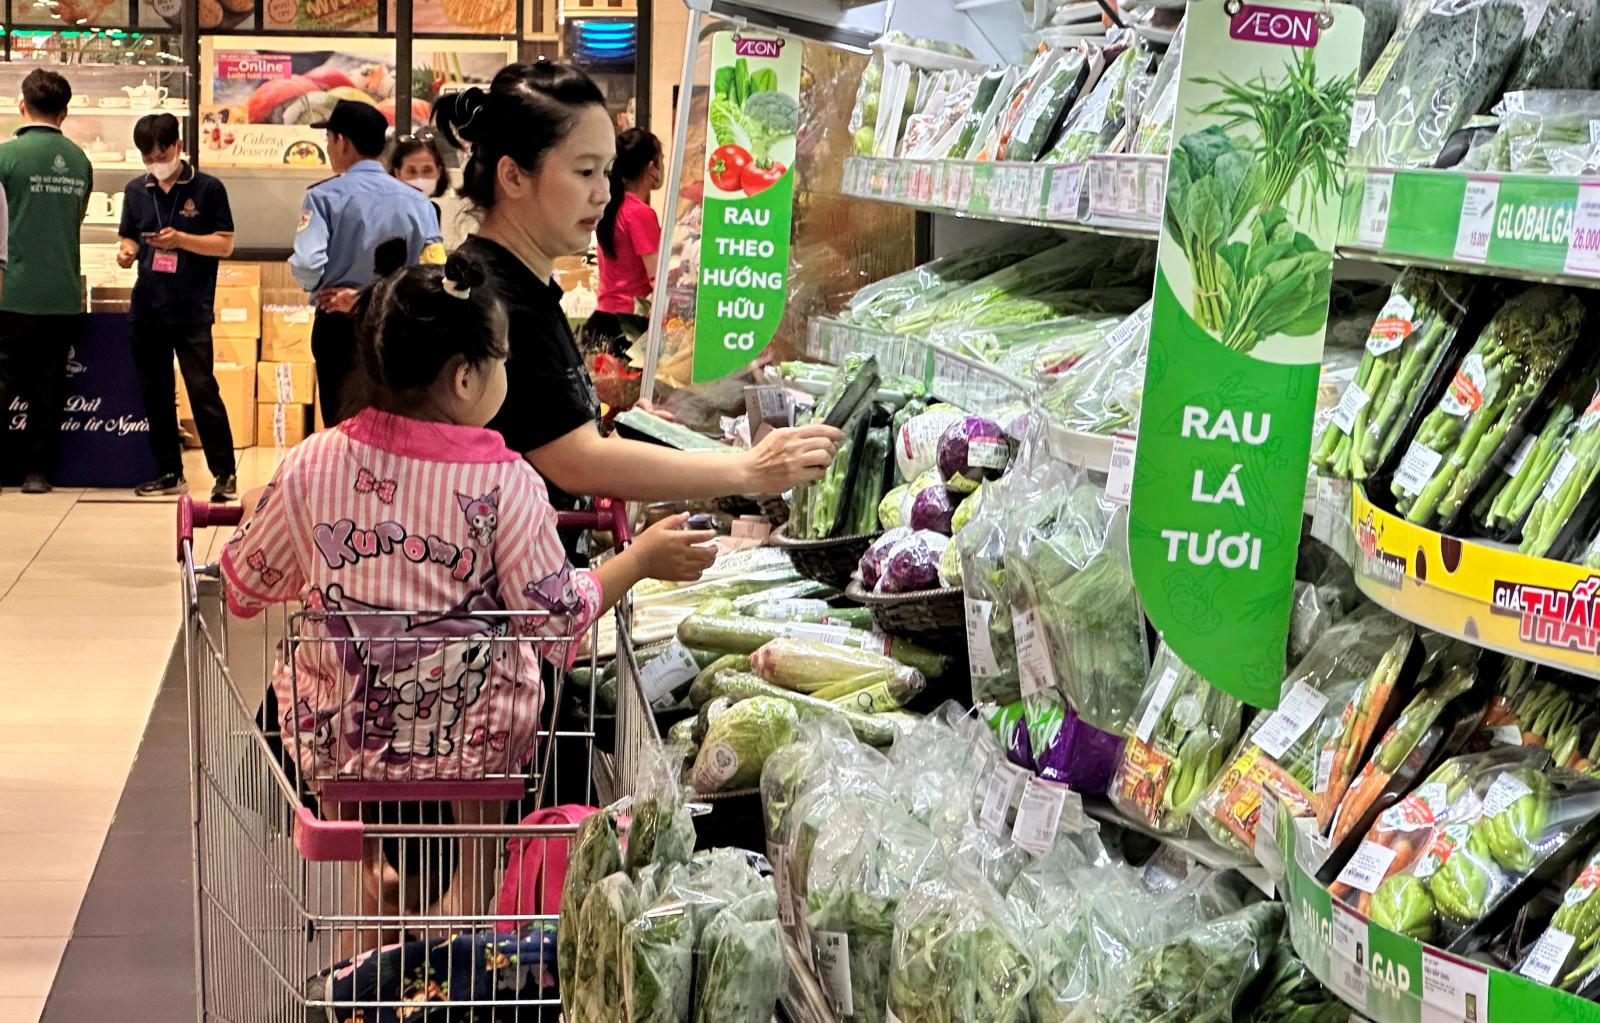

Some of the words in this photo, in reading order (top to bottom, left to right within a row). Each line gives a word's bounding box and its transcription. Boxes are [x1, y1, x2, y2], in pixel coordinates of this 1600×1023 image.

[239, 60, 284, 72] Online
[243, 132, 276, 145] Cakes
[232, 144, 279, 157] Desserts
[723, 206, 770, 227] RAU
[715, 238, 775, 258] THEO
[703, 266, 783, 290] HƯỚNG
[717, 297, 765, 320] HỮU
[723, 331, 755, 351] CƠ
[1181, 405, 1272, 446] RAU
[1191, 464, 1246, 506] LÁ
[313, 518, 477, 582] Kuromi
[1161, 529, 1262, 571] TƯƠI
[1496, 585, 1520, 611] GIÁ
[1372, 951, 1410, 993] GAP
